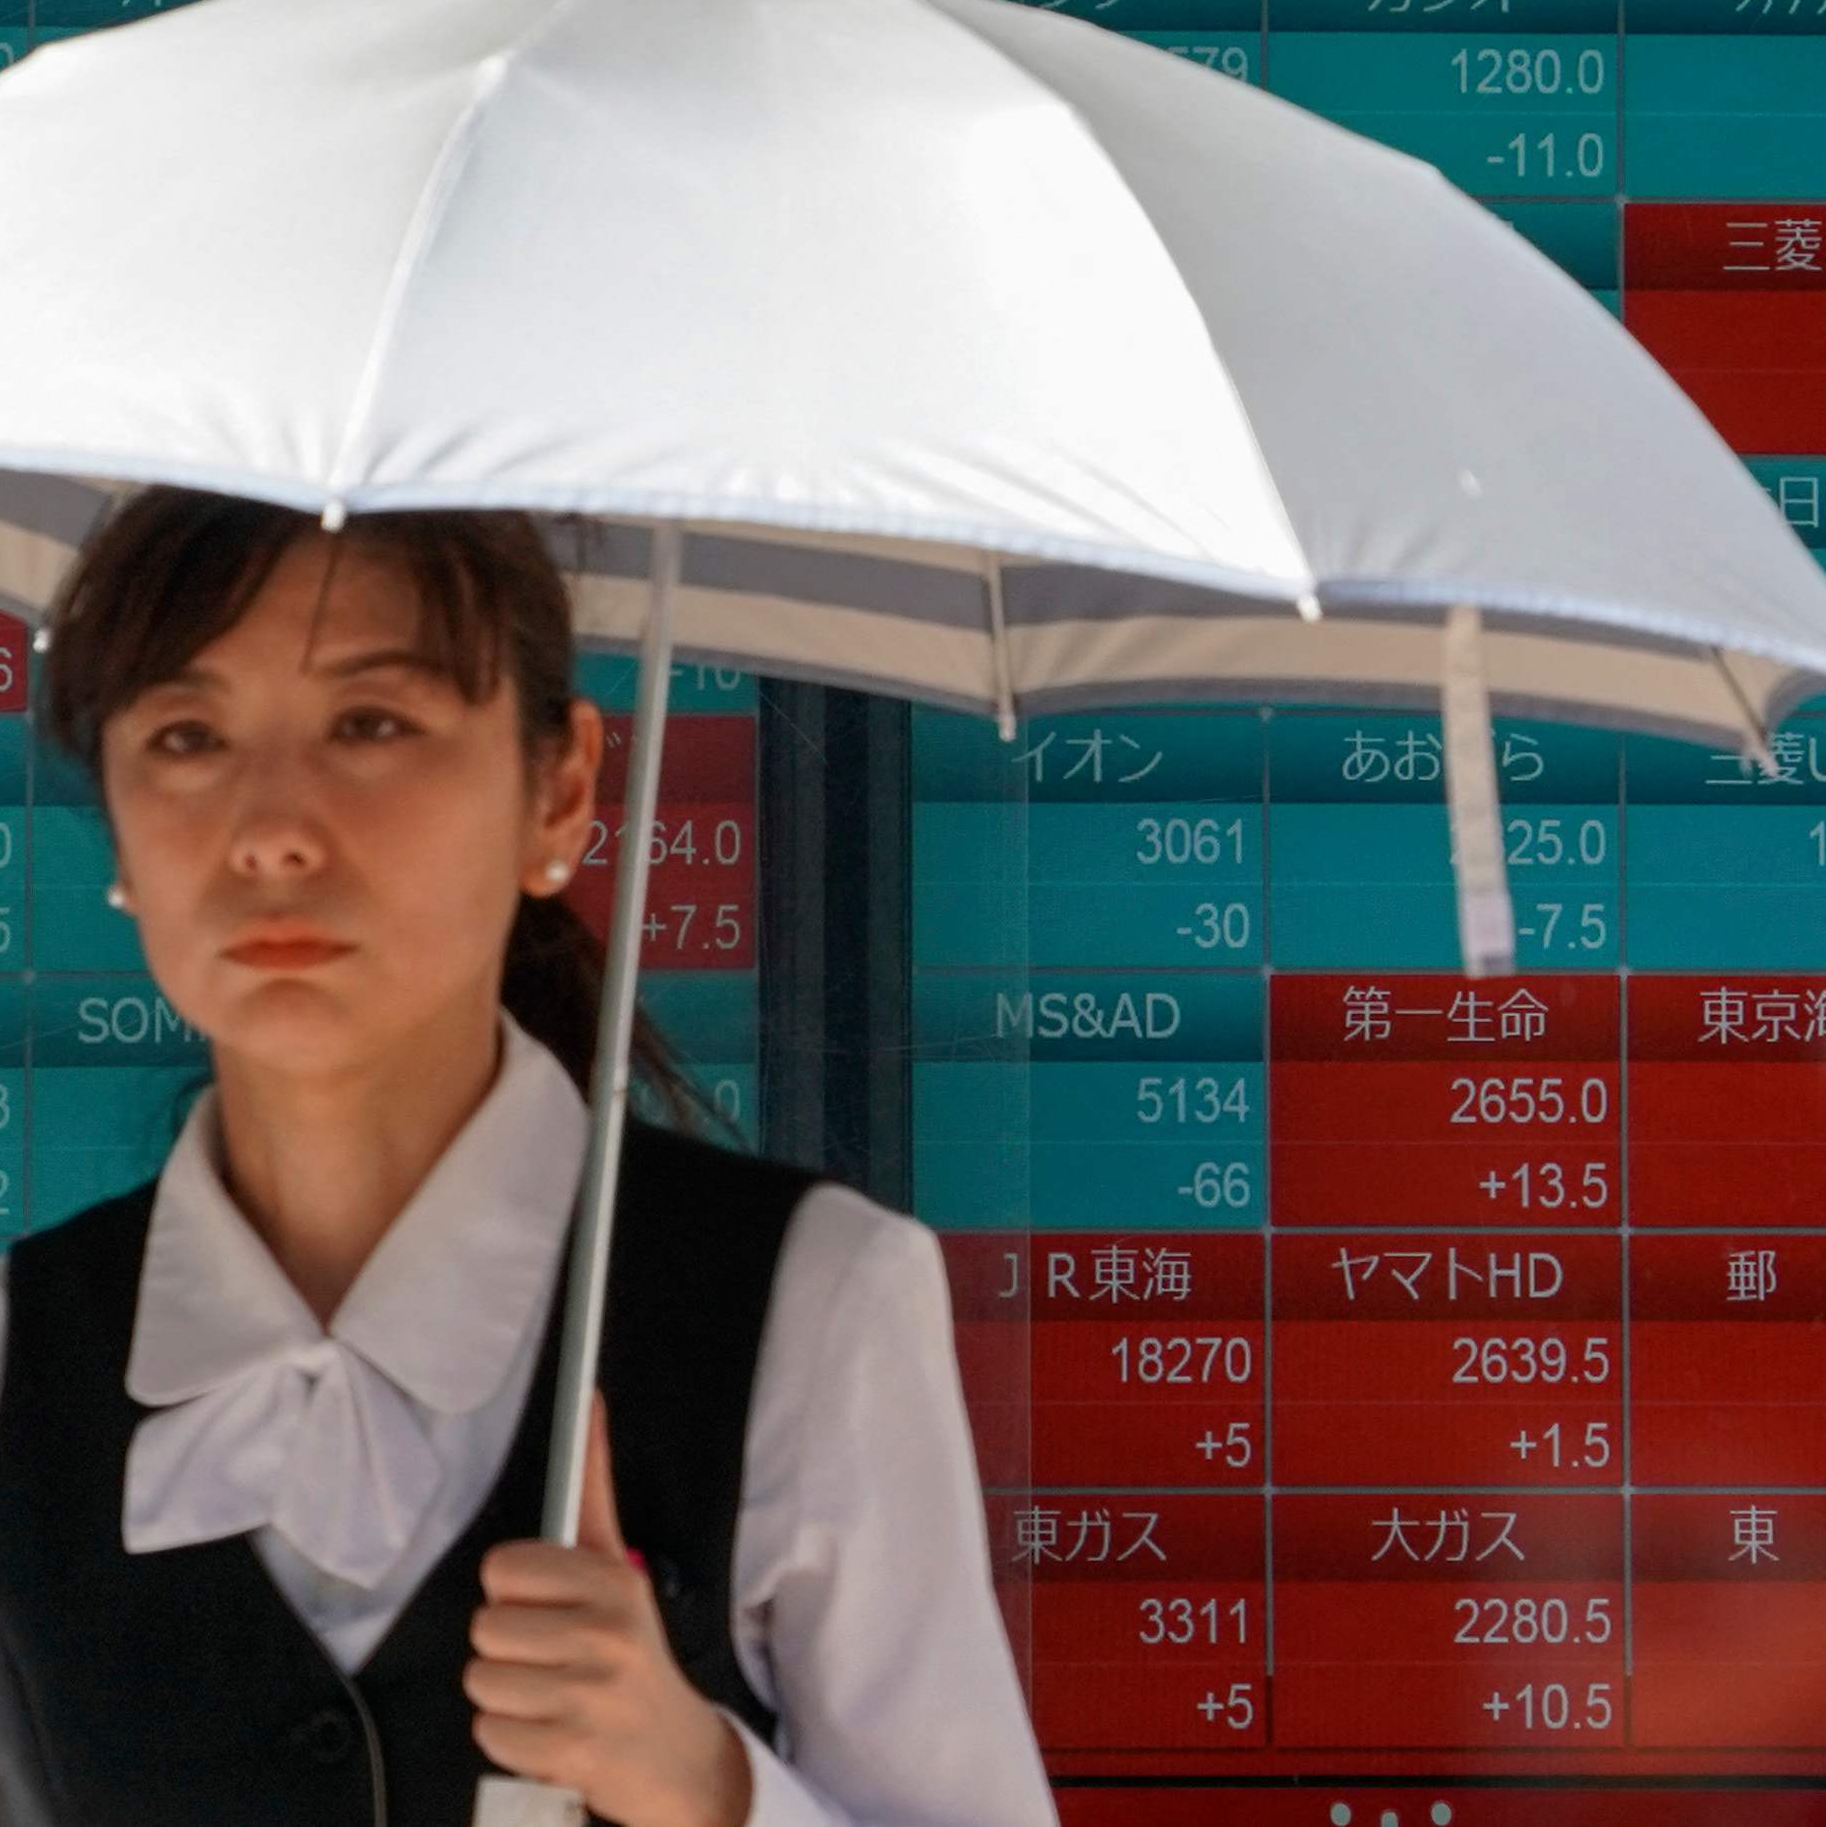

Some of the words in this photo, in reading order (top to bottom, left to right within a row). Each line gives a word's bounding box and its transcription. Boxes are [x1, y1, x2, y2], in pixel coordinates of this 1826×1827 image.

[1452, 48, 1604, 94] 1280.0
[996, 991, 1180, 1039] MS&AD
[1342, 984, 1549, 1042] 第一生命
[1449, 1076, 1608, 1124] 2655.0
[1331, 1246, 1564, 1302] ヤマトHD
[1111, 1336, 1252, 1384] 18270
[1013, 1506, 1167, 1563] 東ガス
[1453, 1597, 1612, 1644] 2280.5
